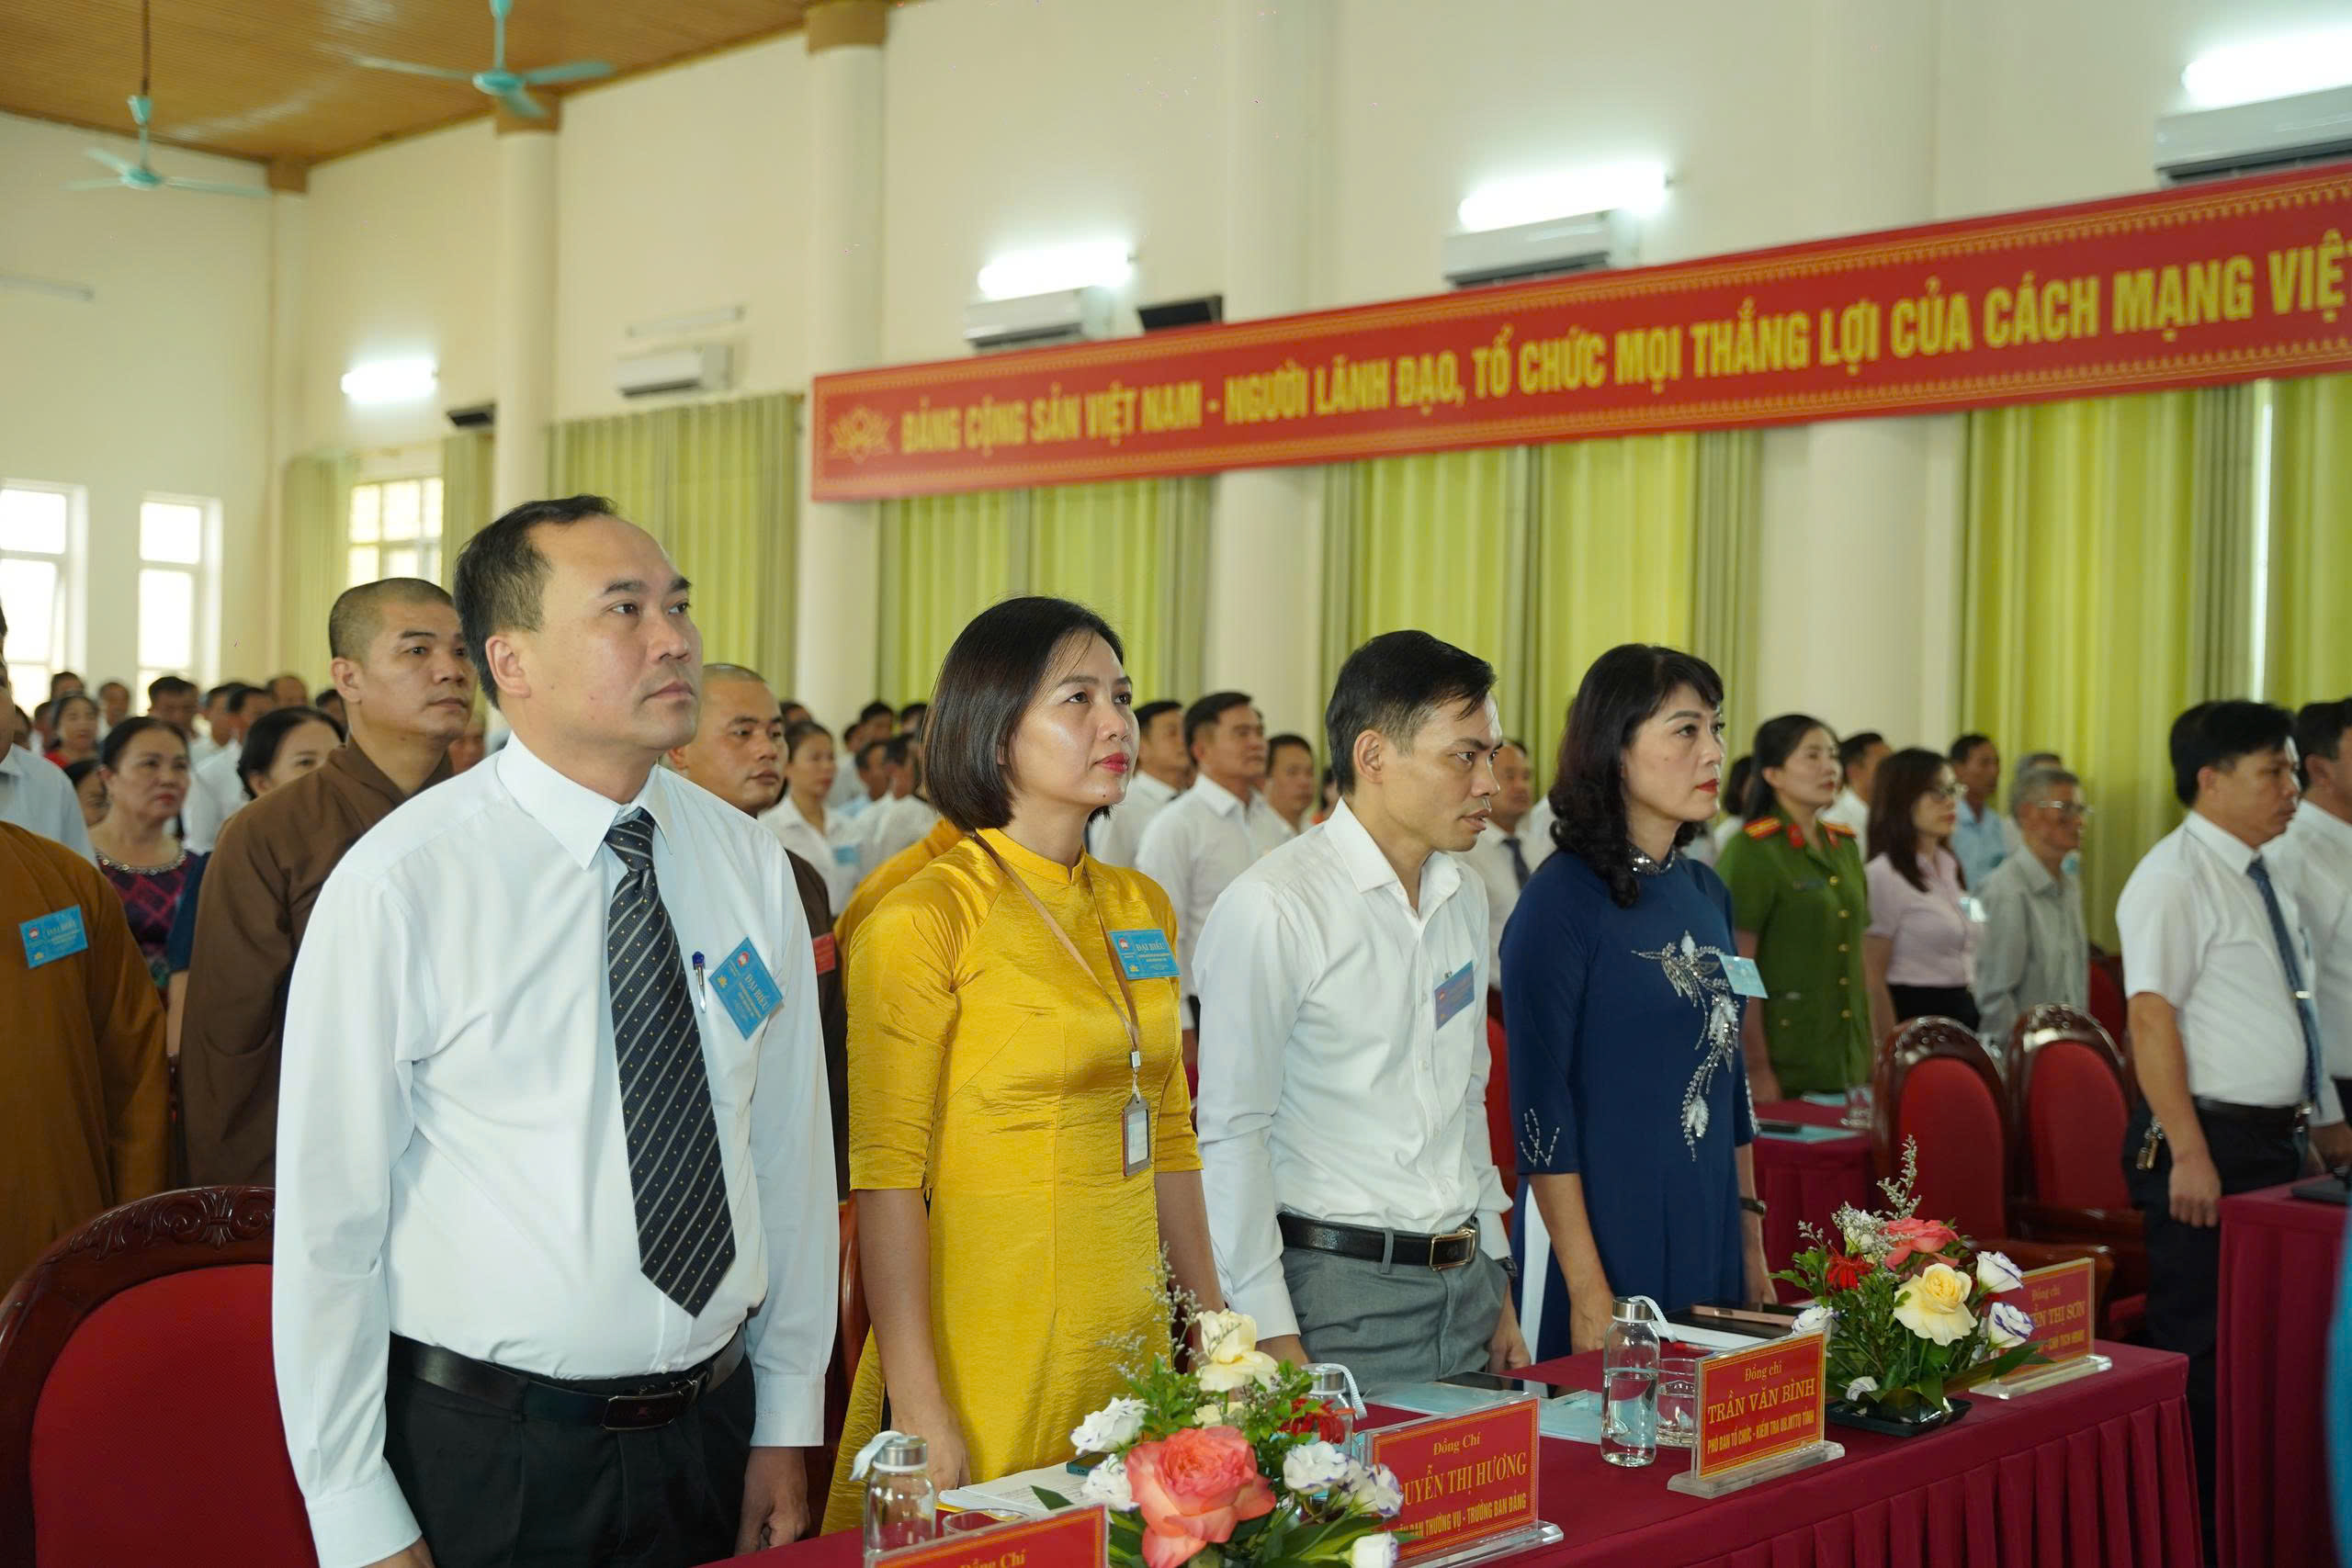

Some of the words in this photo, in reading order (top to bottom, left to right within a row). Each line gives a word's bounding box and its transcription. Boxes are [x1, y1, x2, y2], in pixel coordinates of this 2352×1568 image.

[901, 396, 961, 453] ĐẢNG
[966, 394, 1027, 457] CỘNG
[1031, 381, 1081, 444] SẢN
[1085, 380, 1137, 446] VIỆT
[1141, 380, 1202, 432] NAM
[1225, 358, 1309, 424] NGƯỜI
[1315, 355, 1390, 415] LÃNH
[1396, 350, 1466, 415] ĐẠO,
[1472, 323, 1514, 398] TỔ
[1519, 325, 1606, 395] CHỨC
[1614, 326, 1682, 393] MỌI
[1690, 296, 1811, 378] THẮNG
[1819, 299, 1881, 377] LỢI
[1890, 276, 1973, 359] CỦA
[1983, 271, 2101, 348] CÁCH
[2112, 254, 2255, 342] MẠNG
[1745, 1363, 1768, 1382] Đồng
[1708, 1390, 1746, 1424] TRẦN
[1749, 1385, 1779, 1412] VĂN
[1781, 1378, 1815, 1403] BÌNH
[1433, 1438, 1460, 1456] Đồng
[1462, 1432, 1481, 1449] Chí
[1719, 1435, 1730, 1450] BAN
[1448, 1465, 1472, 1495] THỊ
[1476, 1452, 1527, 1486] HƯƠNG
[1425, 1511, 1452, 1537] THƯỜNG
[1453, 1510, 1462, 1531] VỤ
[1467, 1499, 1493, 1525] TRƯỞNG
[1494, 1498, 1507, 1515] BAN
[1509, 1490, 1527, 1513] ĐẢNG
[1000, 1550, 1027, 1568] Chí
